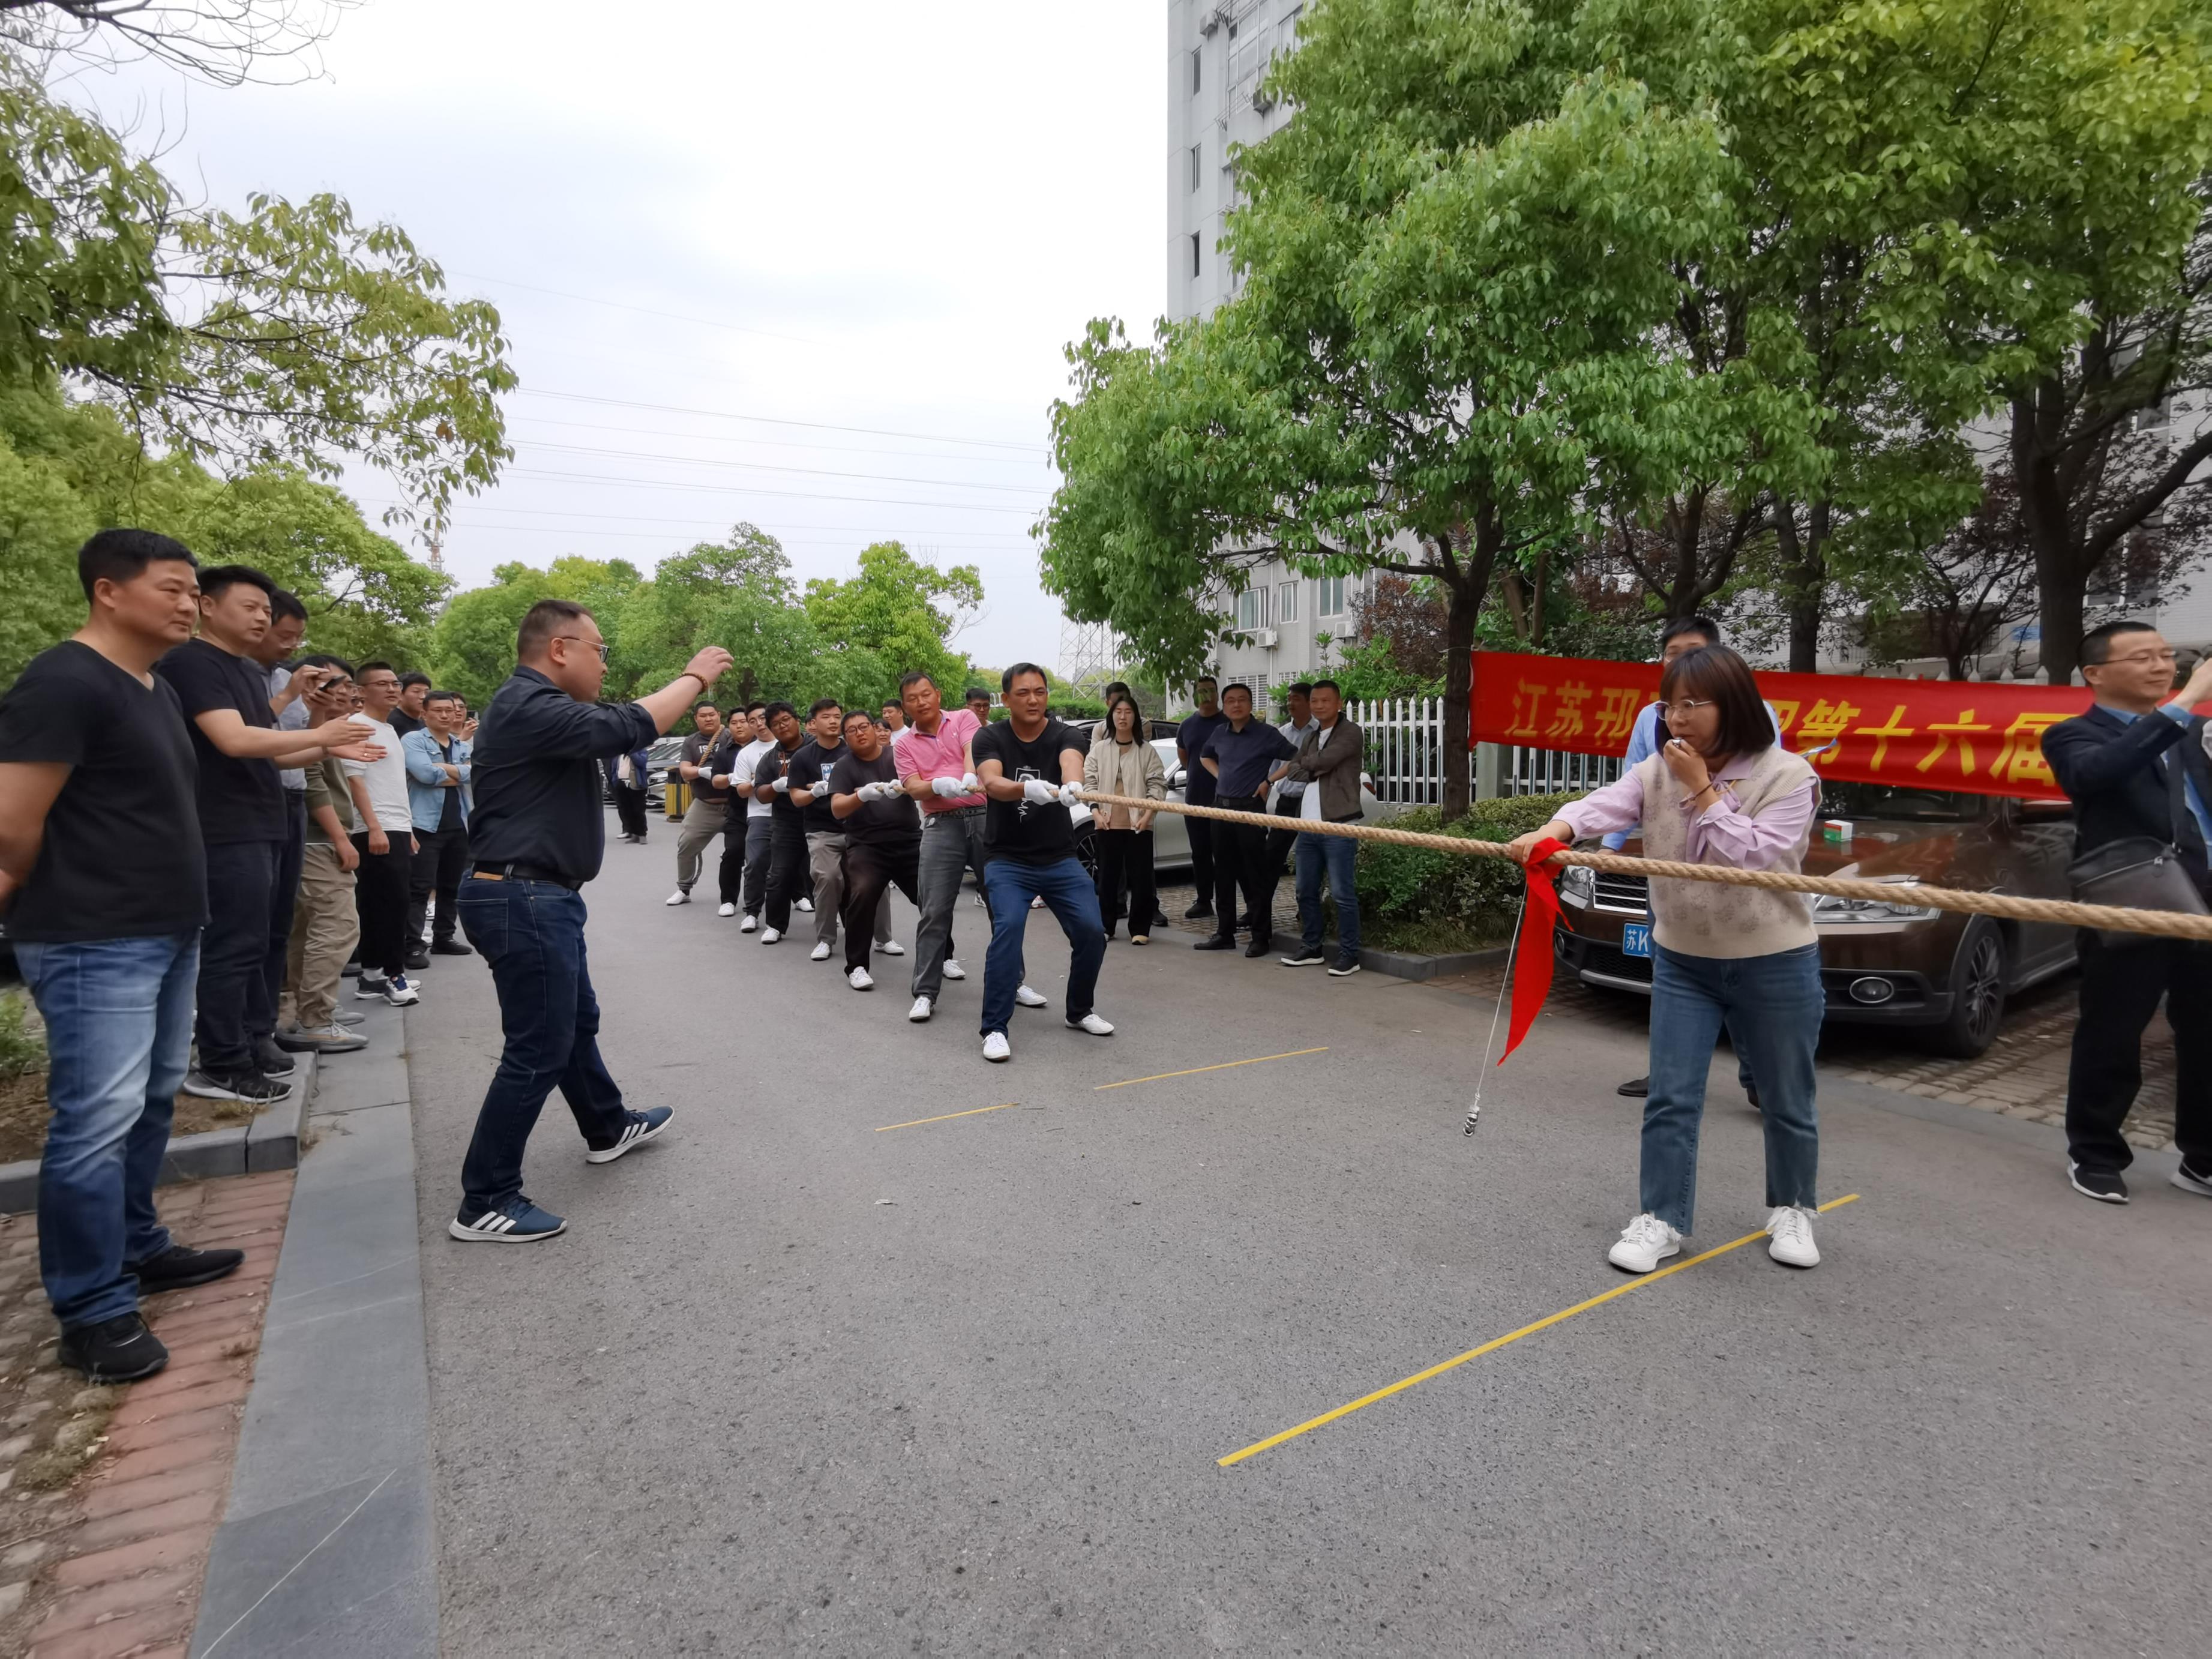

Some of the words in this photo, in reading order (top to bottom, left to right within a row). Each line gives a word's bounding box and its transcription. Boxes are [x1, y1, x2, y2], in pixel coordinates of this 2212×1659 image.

[1504, 676, 2080, 787] 江苏邗第十六届
